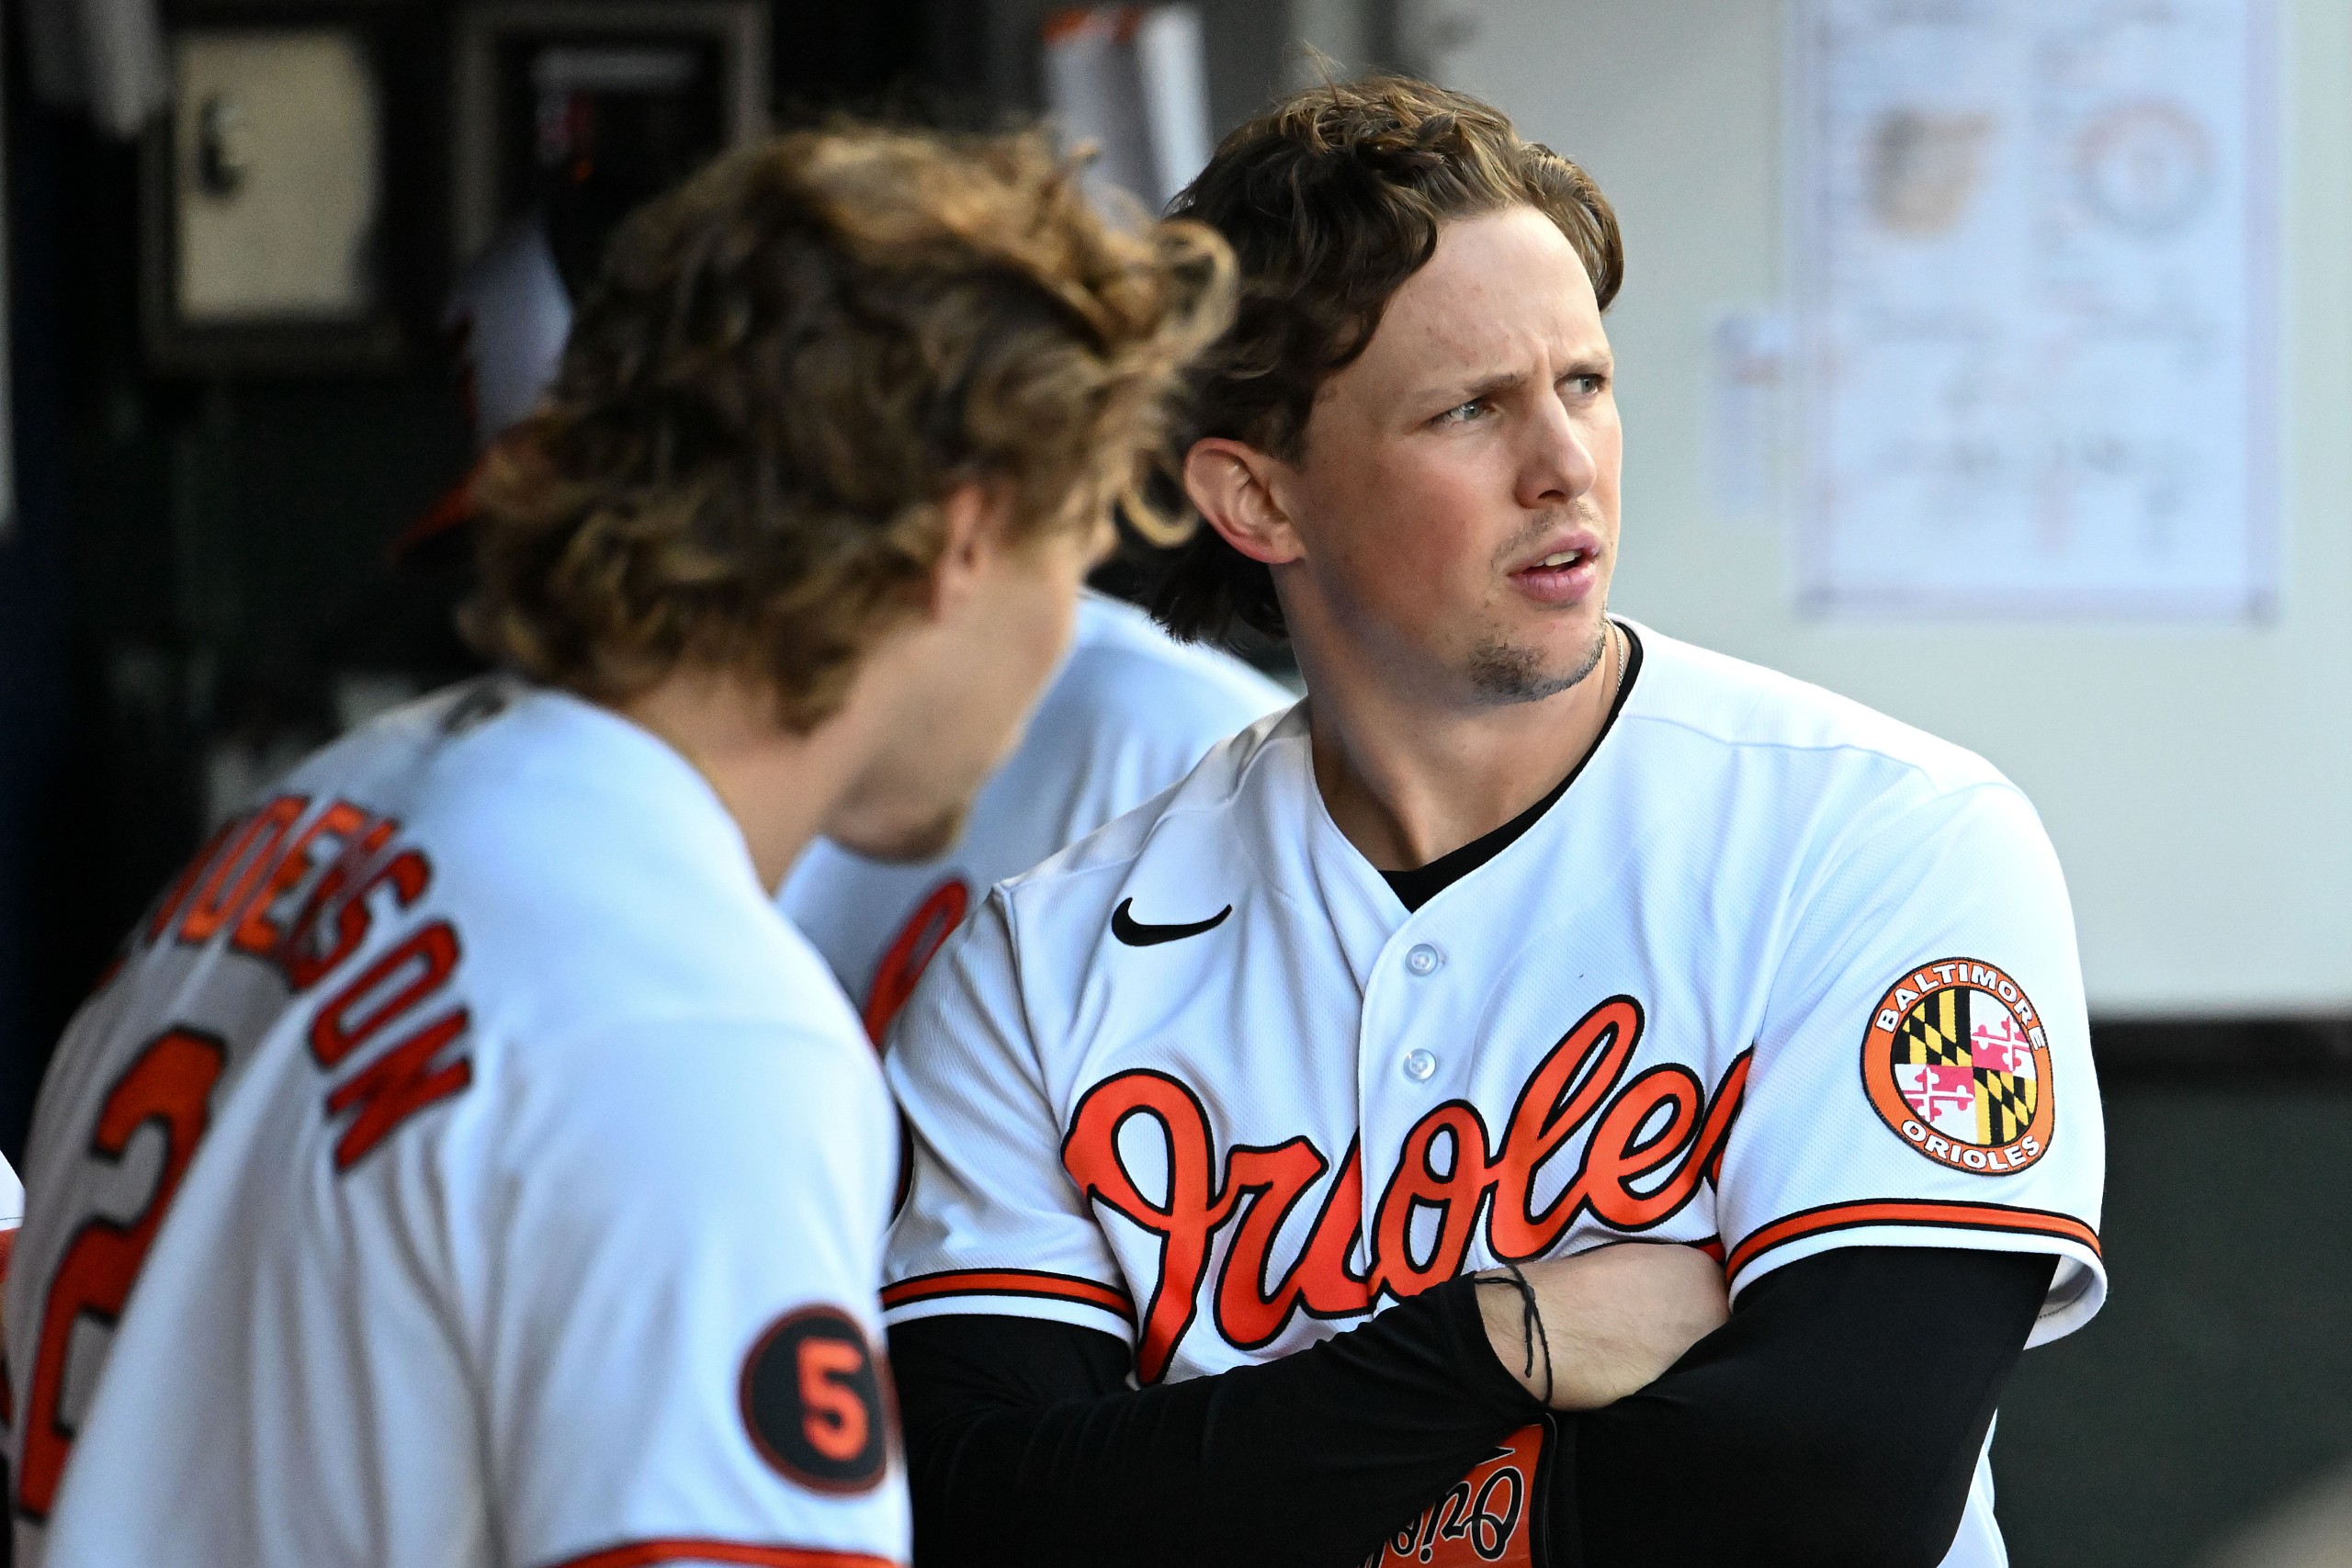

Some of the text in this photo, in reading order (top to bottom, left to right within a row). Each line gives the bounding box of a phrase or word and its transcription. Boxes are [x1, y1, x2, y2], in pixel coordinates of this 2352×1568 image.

[1875, 962, 2046, 1051] BALTIMORE
[1059, 994, 1754, 1385] Oriole
[1901, 1119, 2041, 1171] ORIOLES
[11, 1024, 230, 1527] 2
[796, 1336, 870, 1462] 5
[1358, 1465, 1524, 1568] Orio
